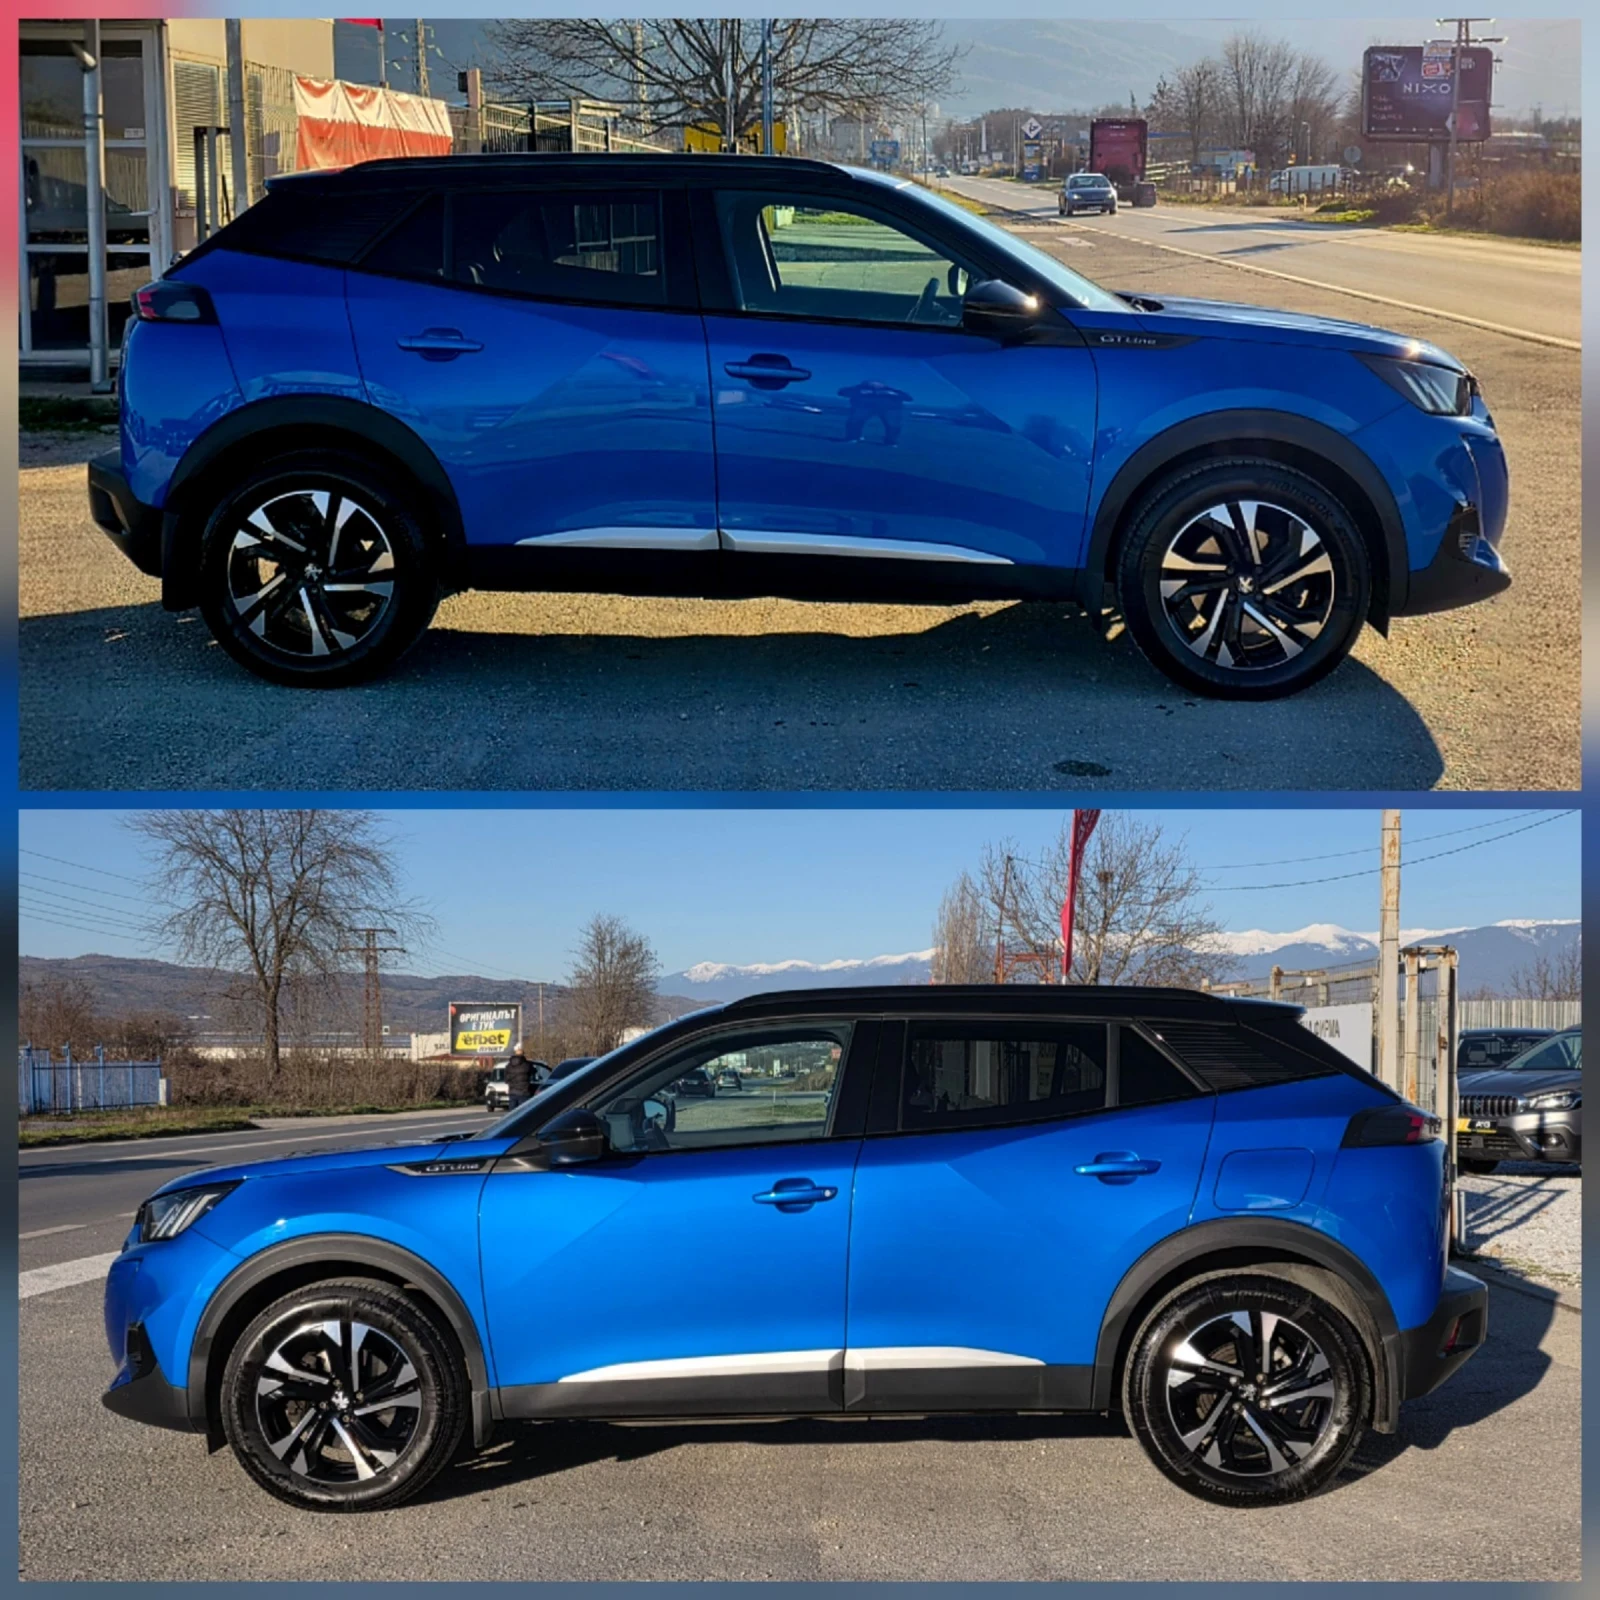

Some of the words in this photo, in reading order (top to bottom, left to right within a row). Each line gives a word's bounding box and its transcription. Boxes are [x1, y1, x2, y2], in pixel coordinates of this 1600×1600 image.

[1403, 83, 1451, 94] NIXO
[460, 1009, 516, 1023] ОРИГИНАЛЪТ
[479, 1020, 495, 1030] ТУК
[462, 1033, 505, 1046] efbet
[426, 1163, 450, 1172] GT
